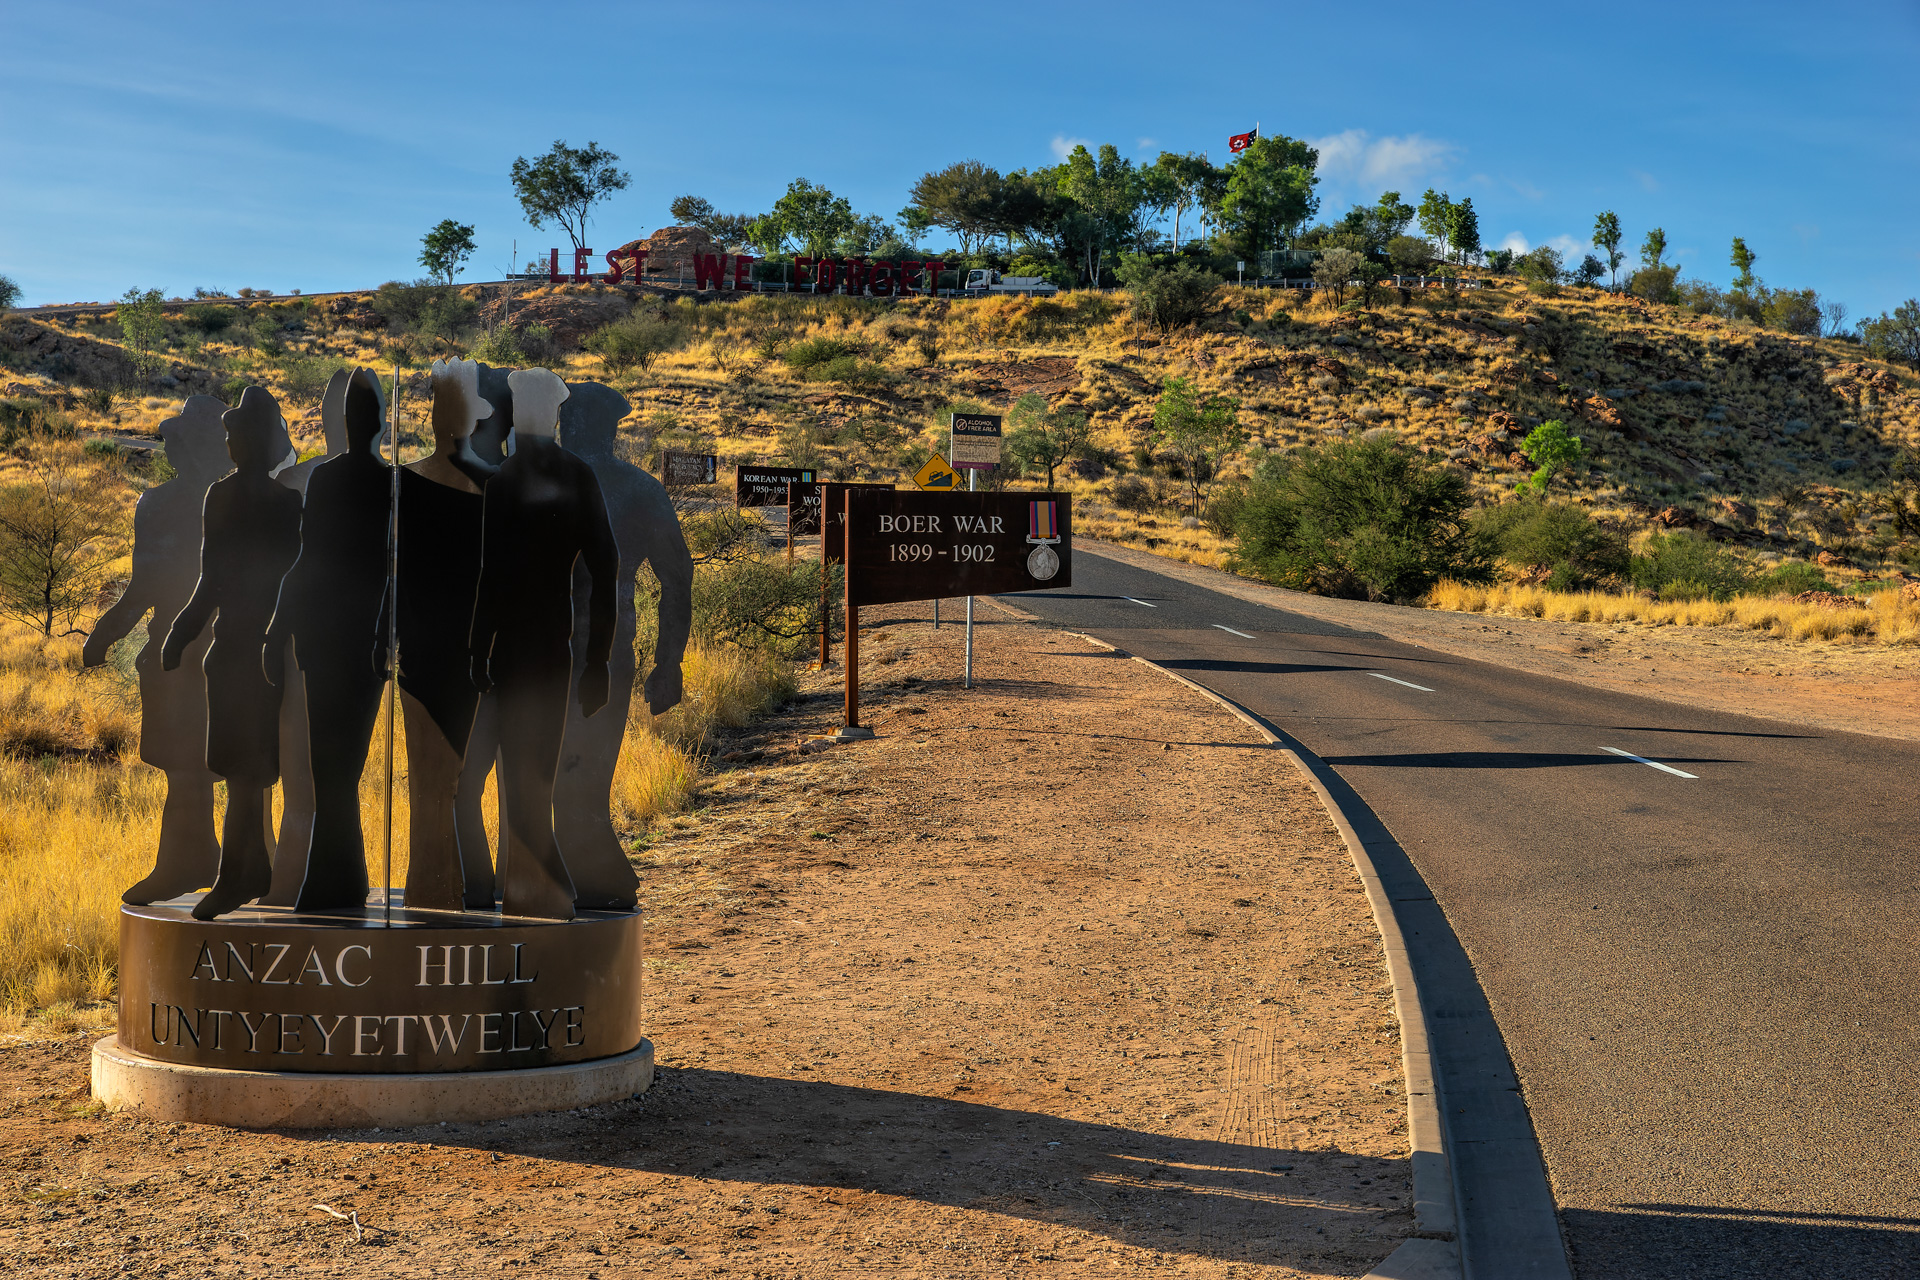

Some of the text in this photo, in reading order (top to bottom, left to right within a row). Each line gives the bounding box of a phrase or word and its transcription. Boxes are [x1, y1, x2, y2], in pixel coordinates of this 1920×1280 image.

[550, 248, 944, 298] LEST WE FORGET
[743, 474, 798, 485] KOREAN WAR
[878, 514, 1006, 534] BOER WAR
[189, 939, 539, 988] ANZAC HILL
[148, 1002, 586, 1058] UNTYEYETWELYE
